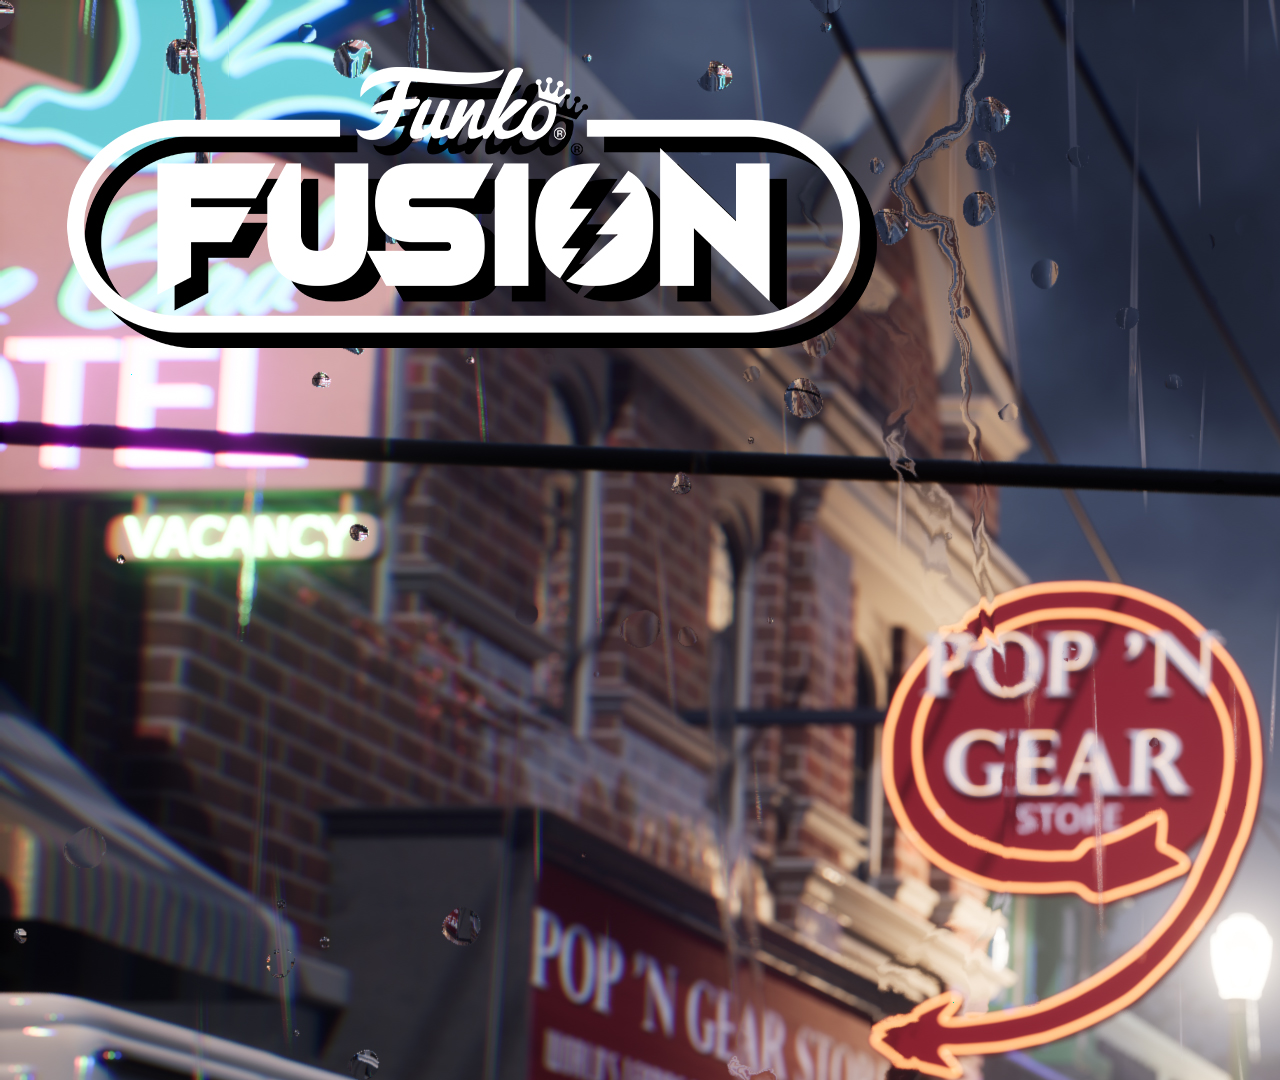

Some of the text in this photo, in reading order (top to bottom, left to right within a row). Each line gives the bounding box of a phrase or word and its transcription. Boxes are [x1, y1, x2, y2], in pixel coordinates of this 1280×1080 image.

[0, 335, 309, 470] TEL
[122, 513, 357, 560] VACANCY
[924, 630, 1097, 699] POP
[943, 728, 1192, 798] GEAR
[1015, 801, 1124, 836] STORE
[530, 906, 626, 1016] POP
